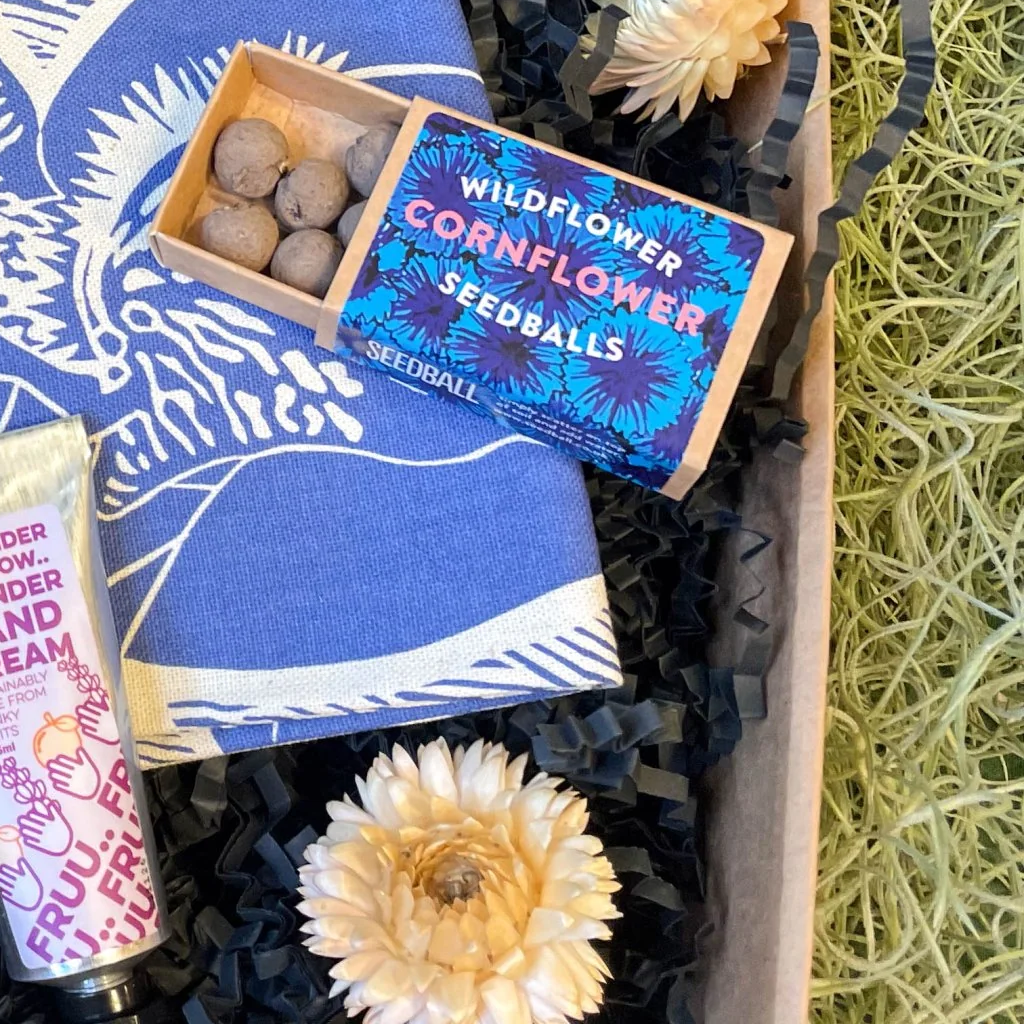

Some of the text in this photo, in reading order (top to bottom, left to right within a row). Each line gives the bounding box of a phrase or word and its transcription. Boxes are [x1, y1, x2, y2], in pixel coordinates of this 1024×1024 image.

[404, 199, 706, 336] CORNFLOWER
[460, 175, 683, 278] WILDFLOWER
[439, 272, 624, 362] SEEDBALLS
[366, 340, 479, 404] SEEDBALL
[7, 686, 47, 706] FROM
